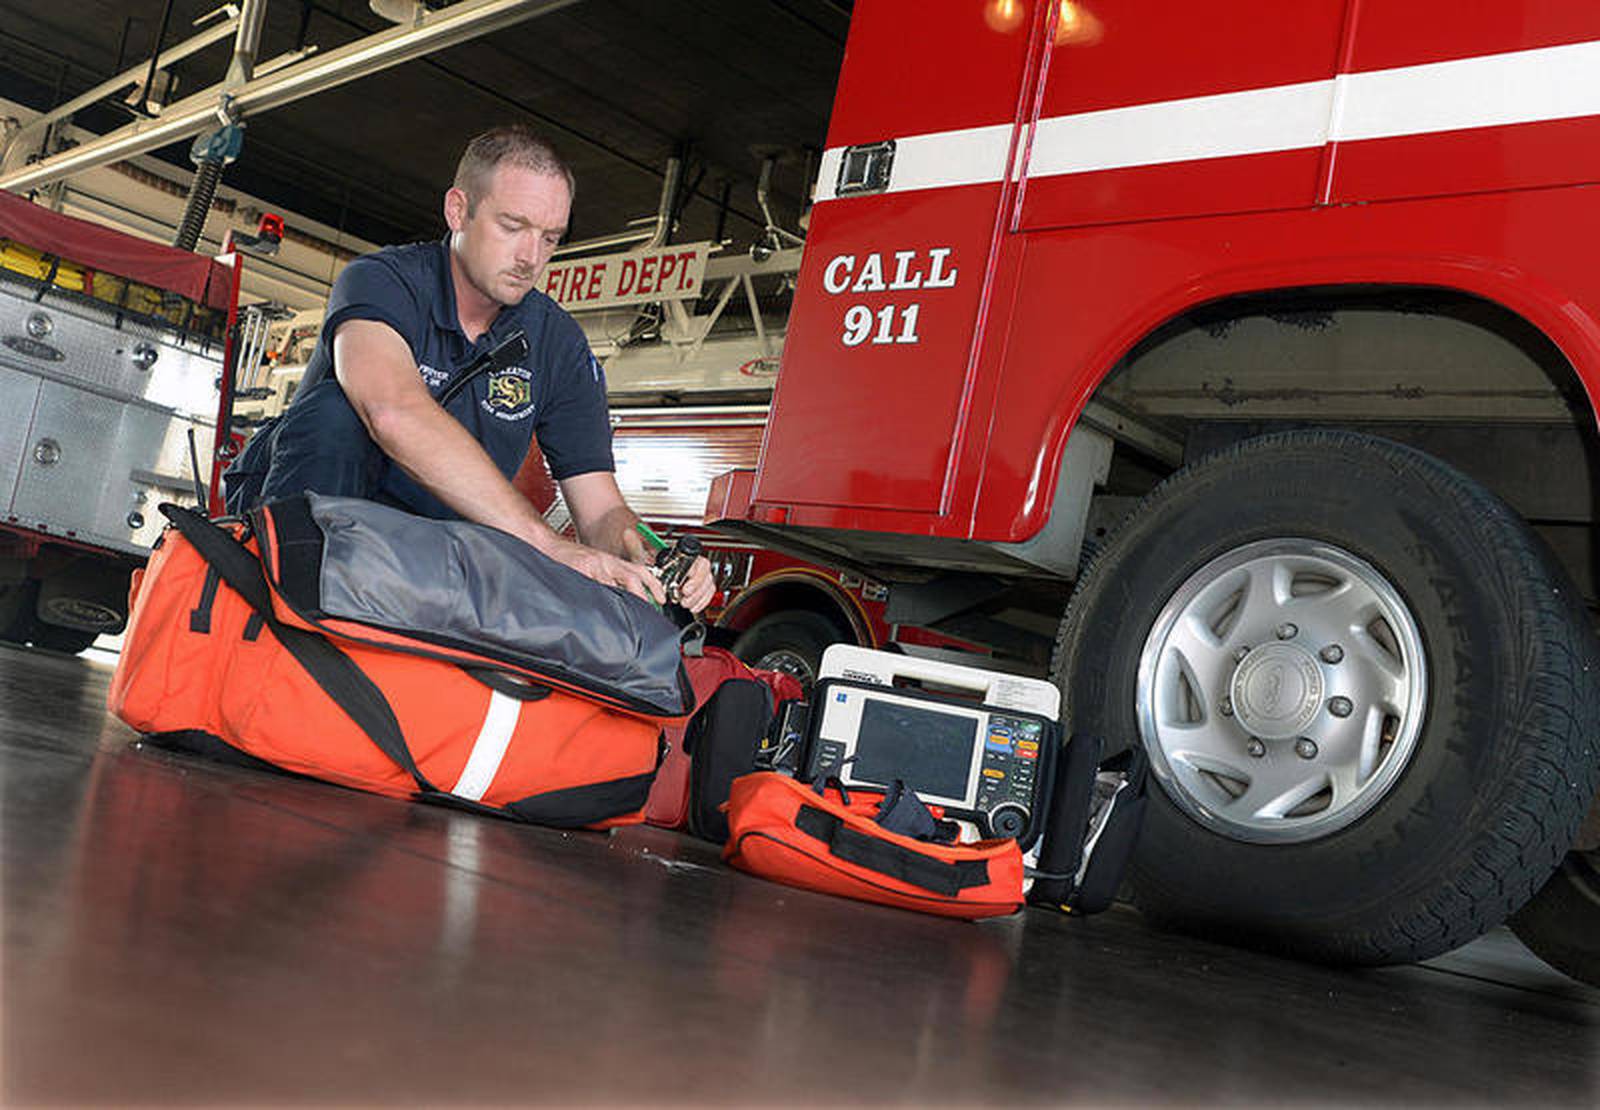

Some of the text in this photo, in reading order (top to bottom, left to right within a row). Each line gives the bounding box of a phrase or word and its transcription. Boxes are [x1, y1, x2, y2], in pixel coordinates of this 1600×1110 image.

[545, 252, 697, 302] FIRE DEPT.
[823, 248, 958, 294] CALL
[842, 303, 920, 346] 911
